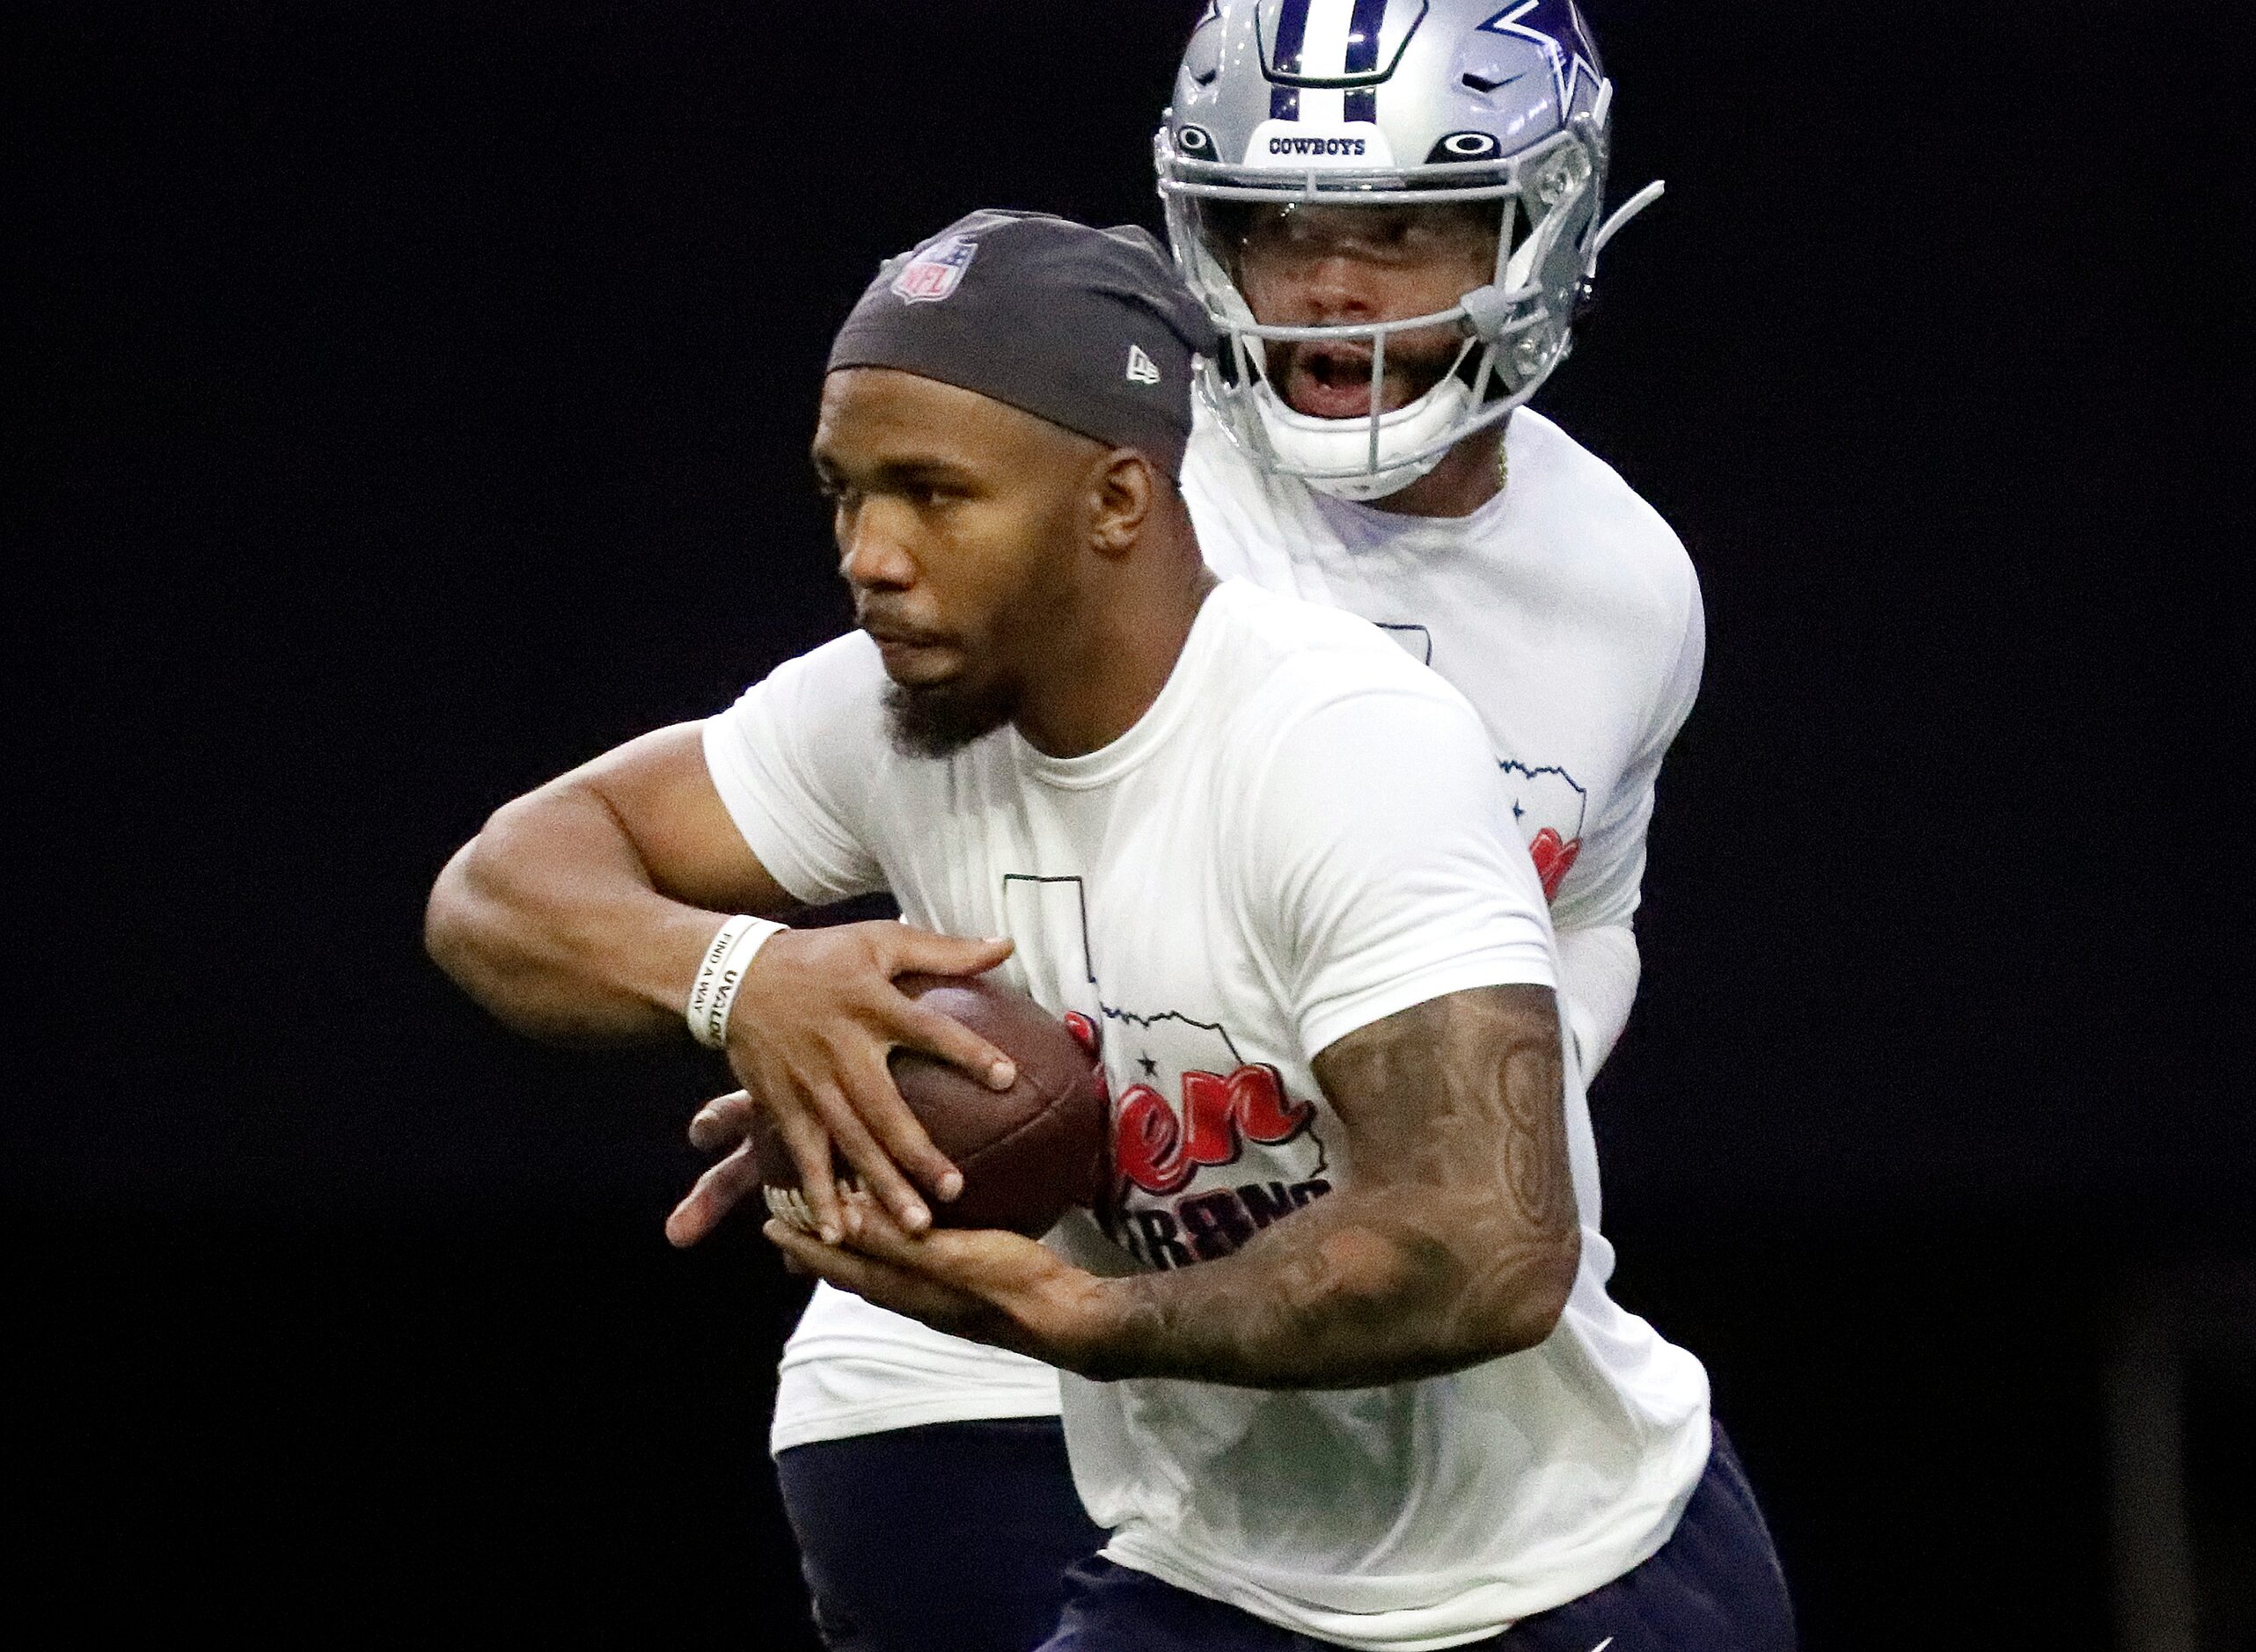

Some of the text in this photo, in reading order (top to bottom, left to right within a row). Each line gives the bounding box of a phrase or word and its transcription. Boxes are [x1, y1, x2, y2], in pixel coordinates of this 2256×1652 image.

[1269, 137, 1366, 156] COWBOYS
[902, 263, 949, 294] NFL
[693, 932, 732, 1014] FIND A WAY
